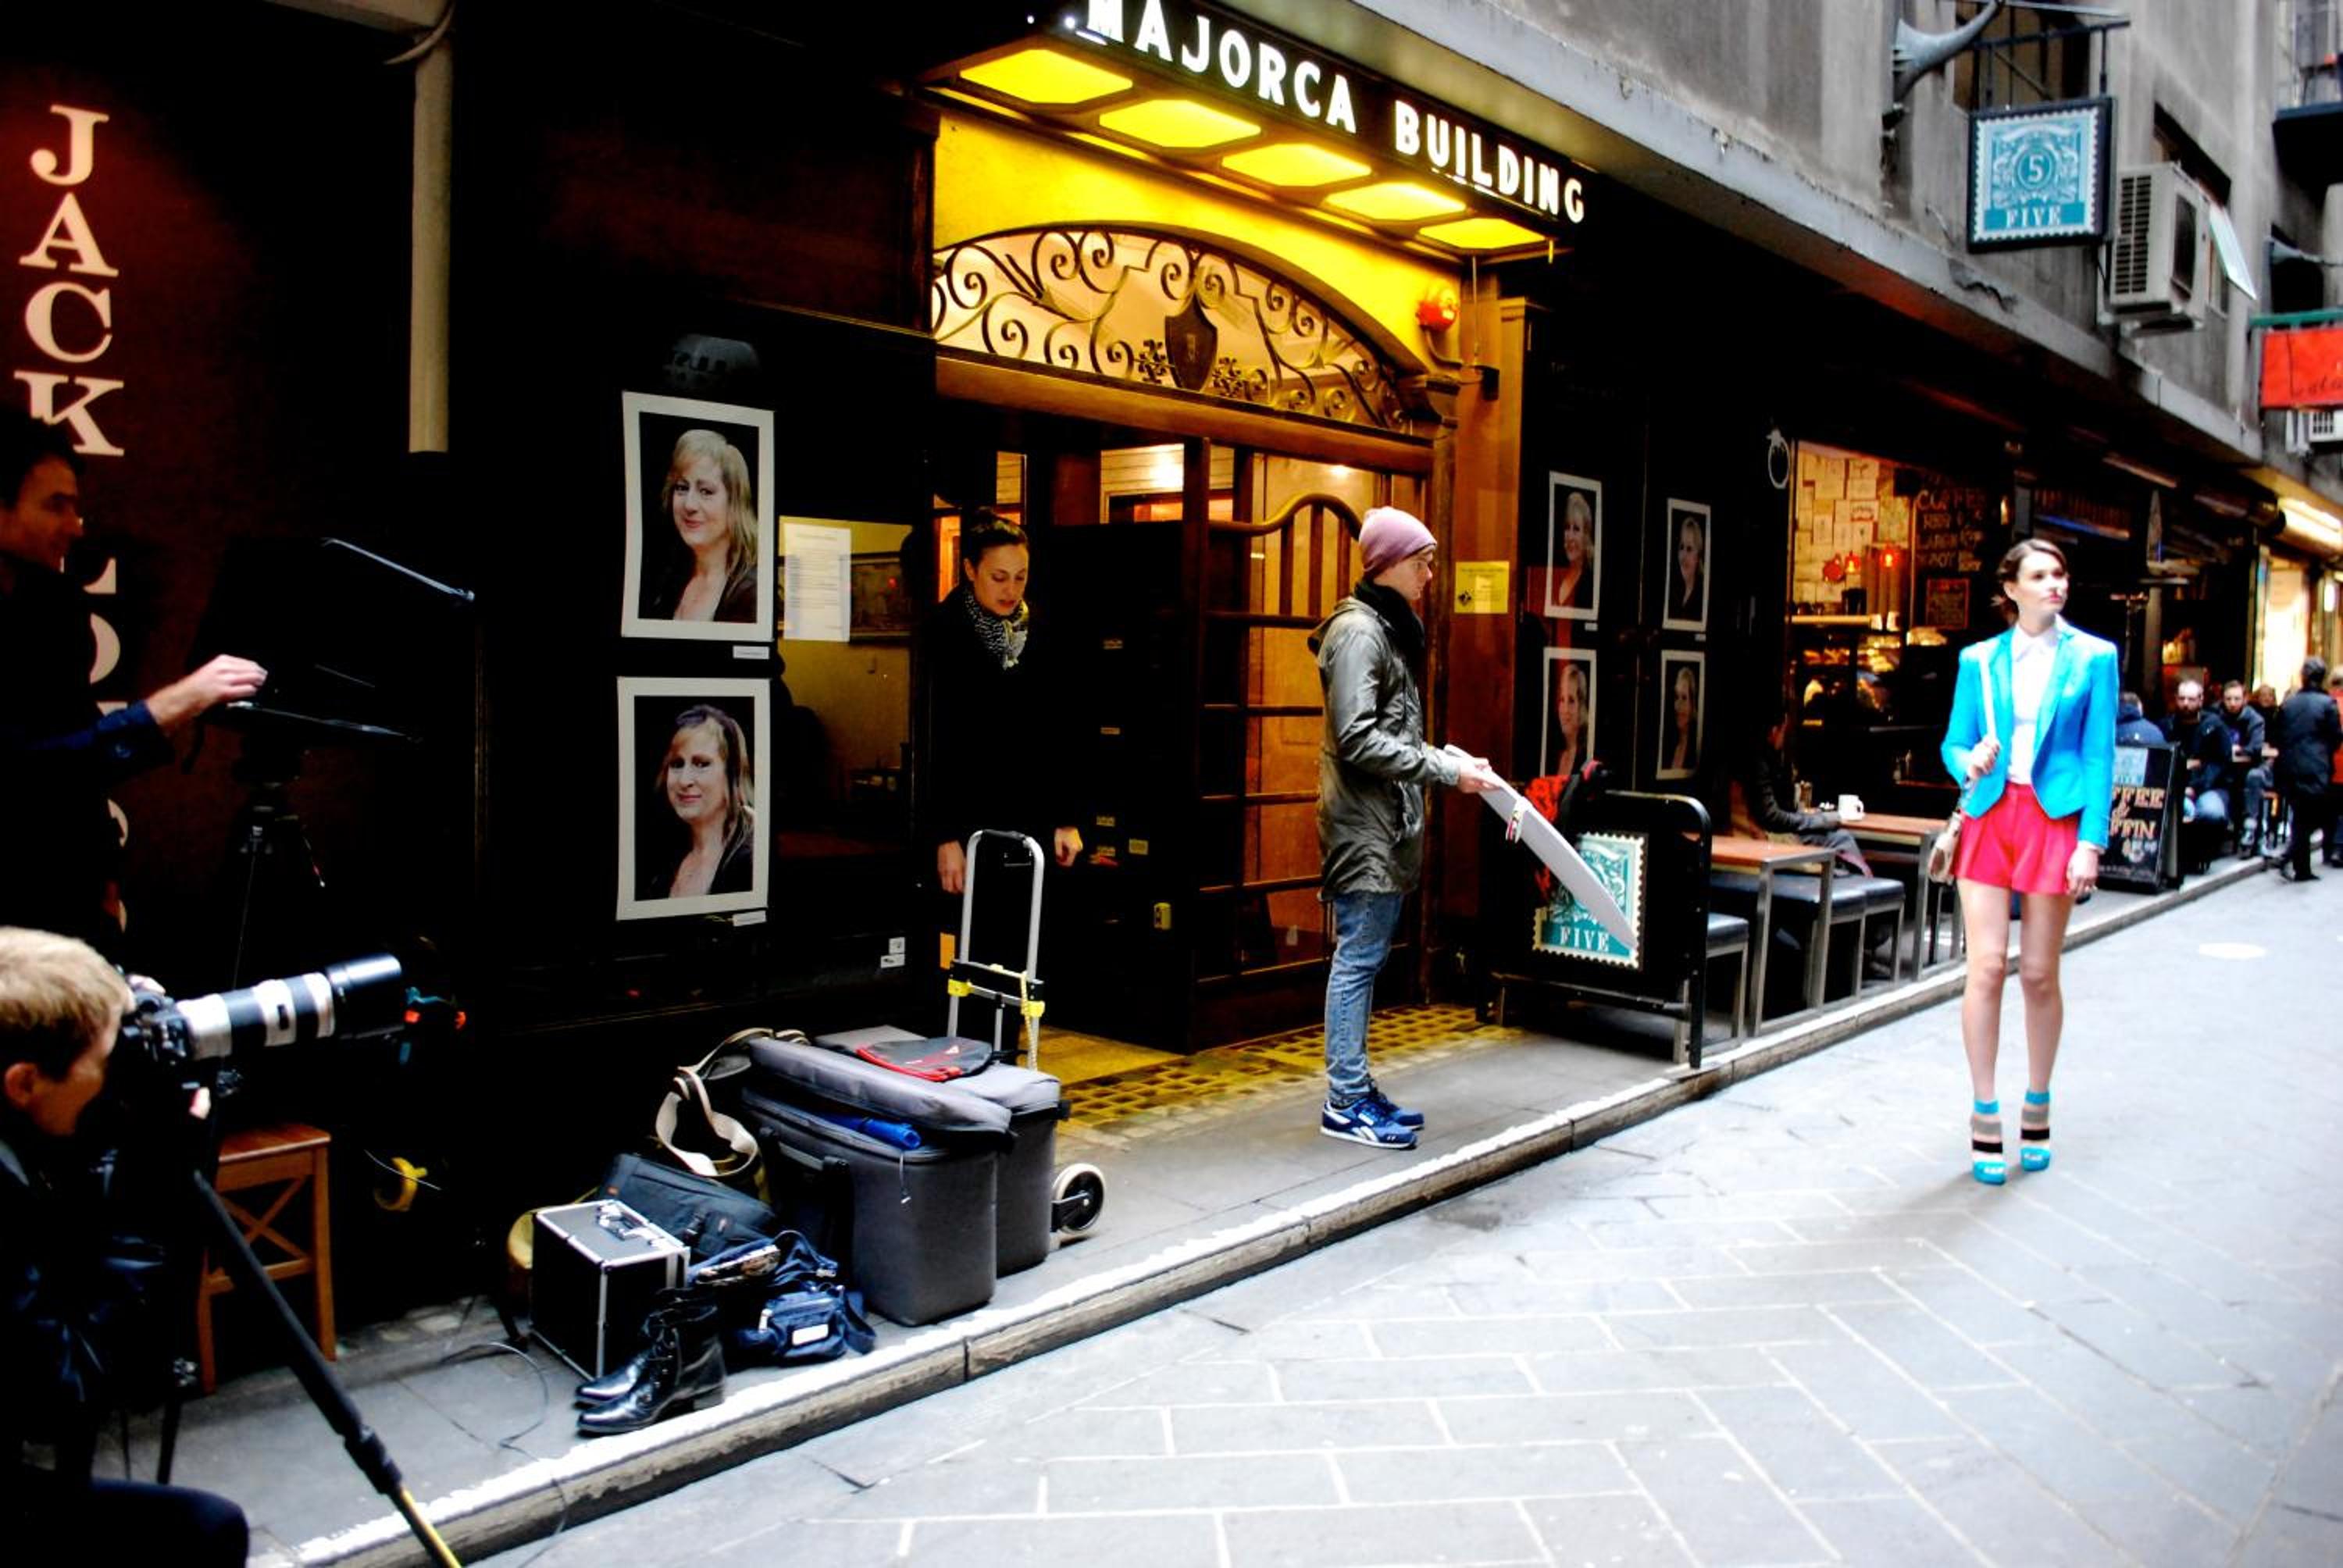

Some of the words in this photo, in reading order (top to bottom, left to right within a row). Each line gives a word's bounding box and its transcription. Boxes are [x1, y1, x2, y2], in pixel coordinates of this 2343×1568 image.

[1086, 0, 1357, 134] MAJORCA
[1394, 98, 1585, 224] BUILDING
[2006, 205, 2062, 229] FIVE
[14, 104, 125, 457] JACK
[1560, 925, 1610, 953] FIVE
